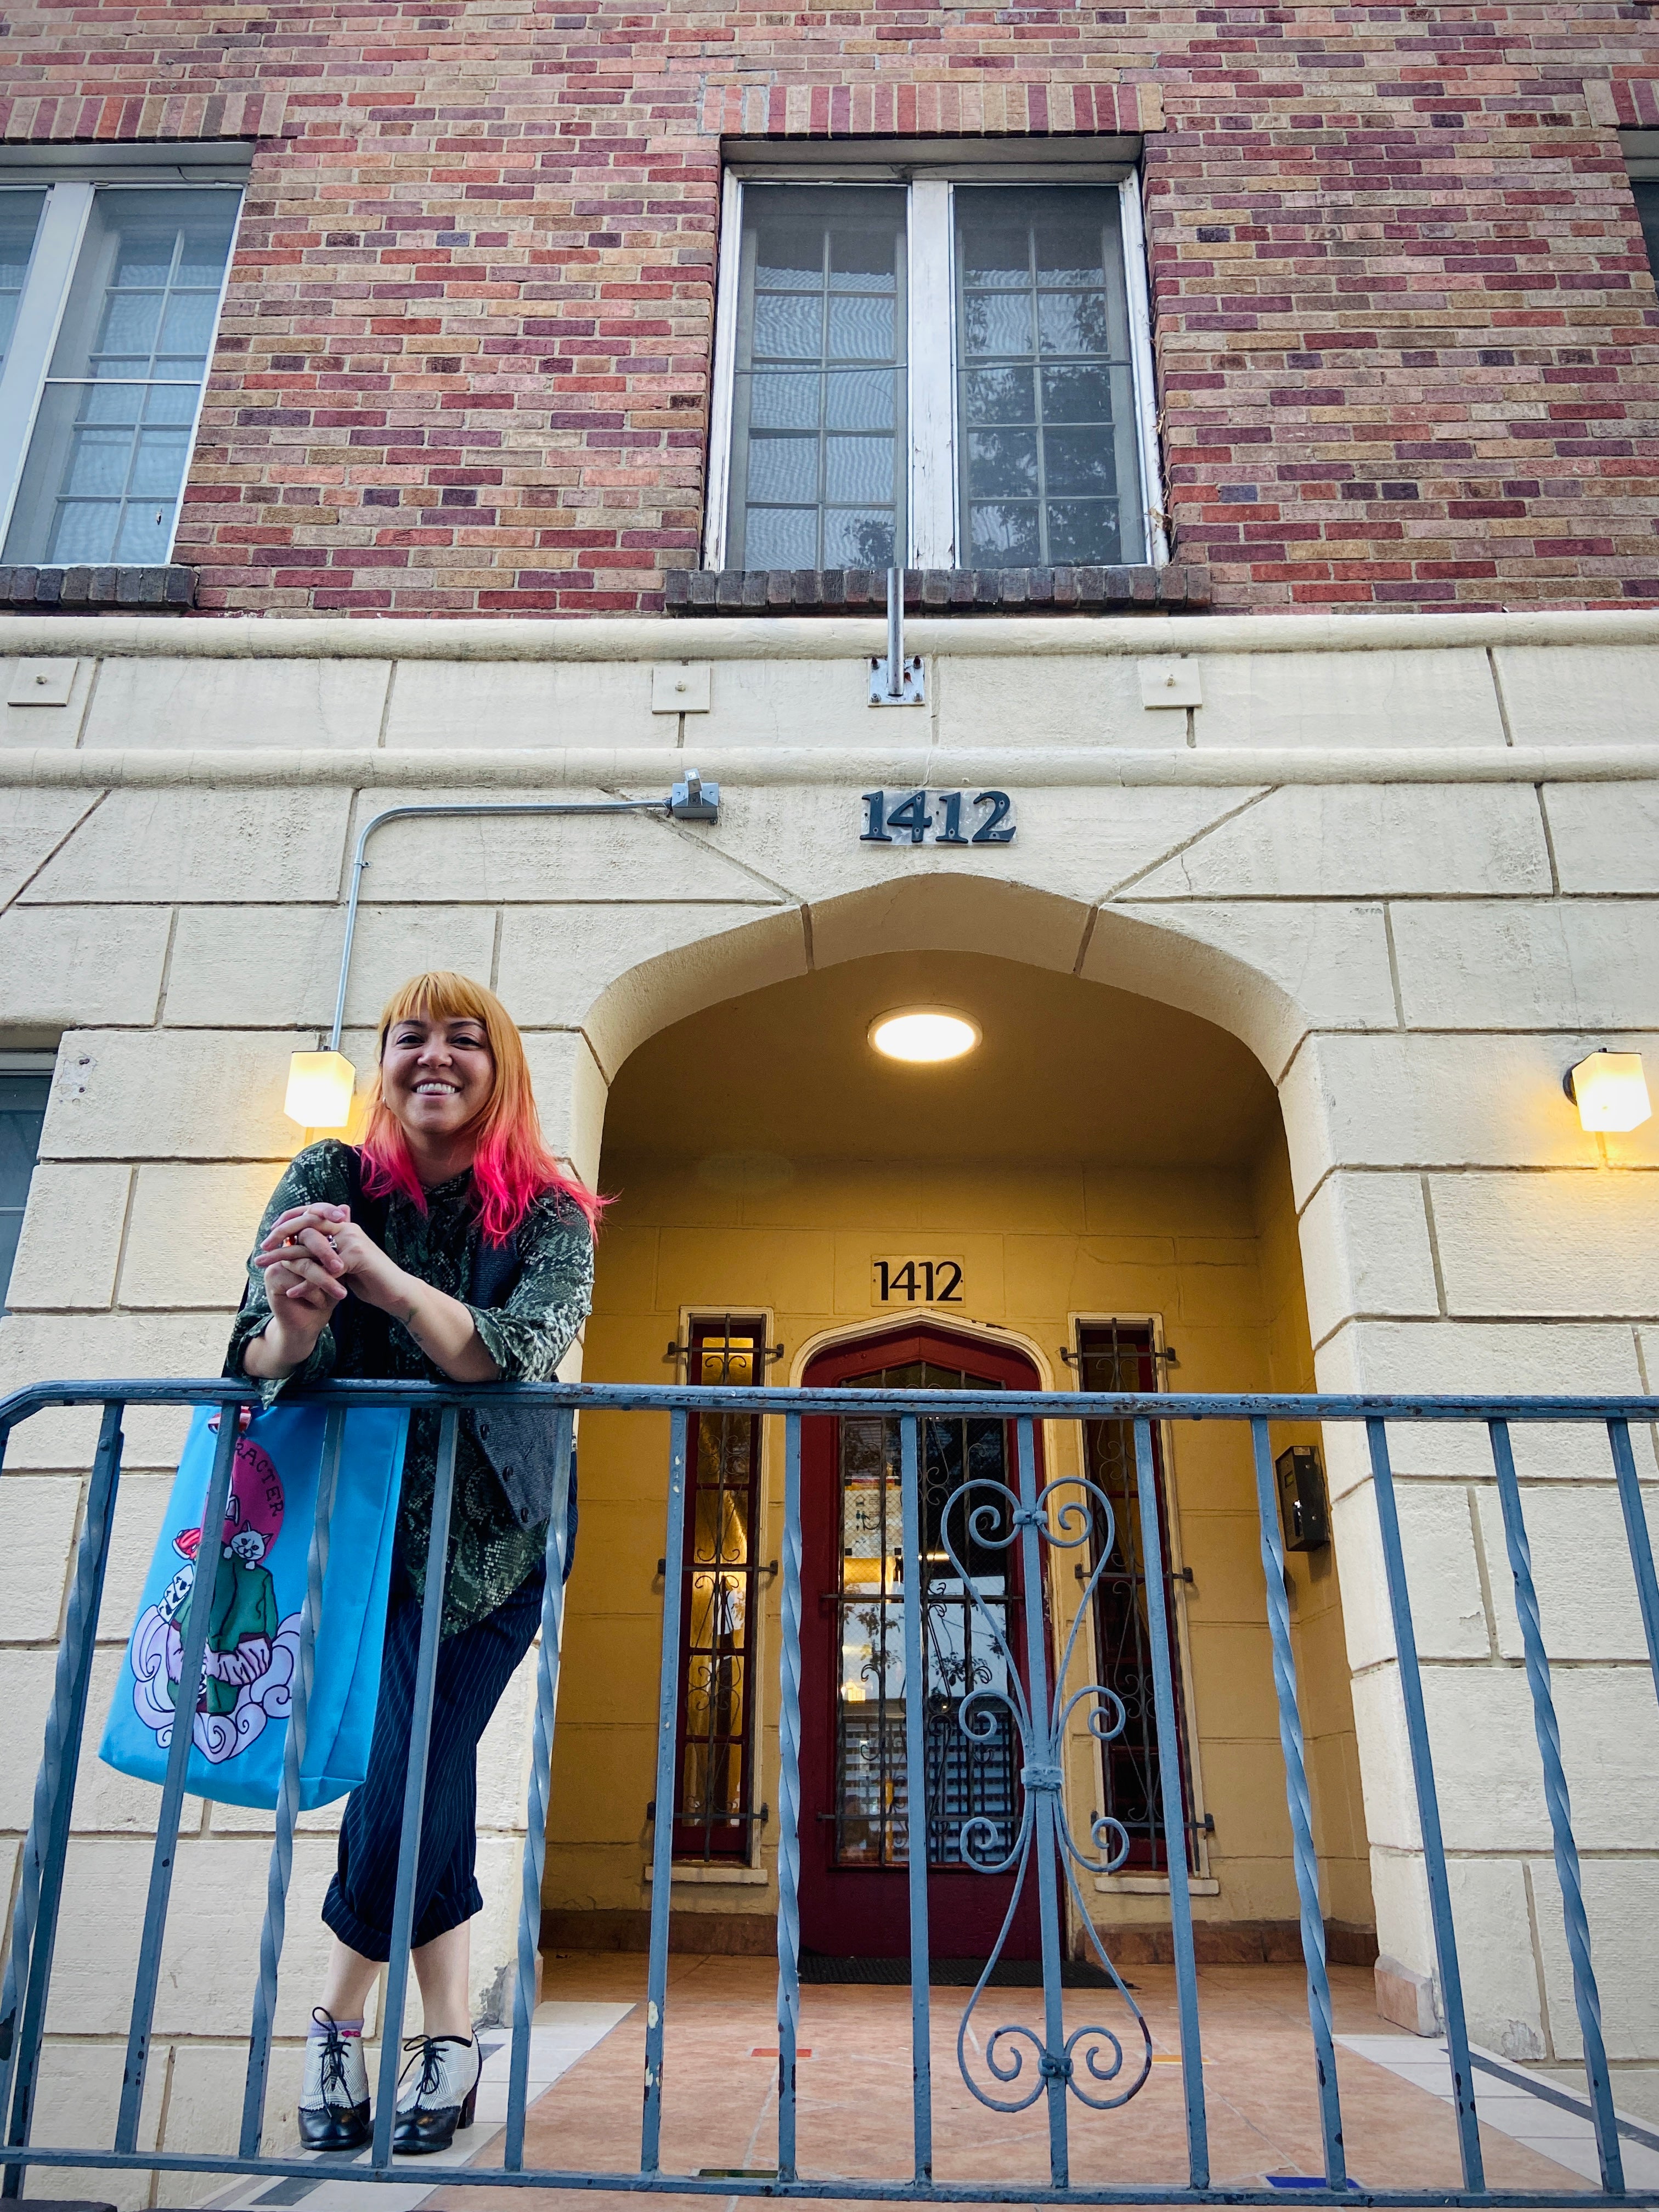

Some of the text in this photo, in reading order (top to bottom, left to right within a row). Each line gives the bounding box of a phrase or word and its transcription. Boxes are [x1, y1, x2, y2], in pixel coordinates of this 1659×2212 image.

[860, 791, 1016, 843] 1412
[874, 1261, 962, 1301] 1412
[235, 1442, 284, 1517] RACTER
